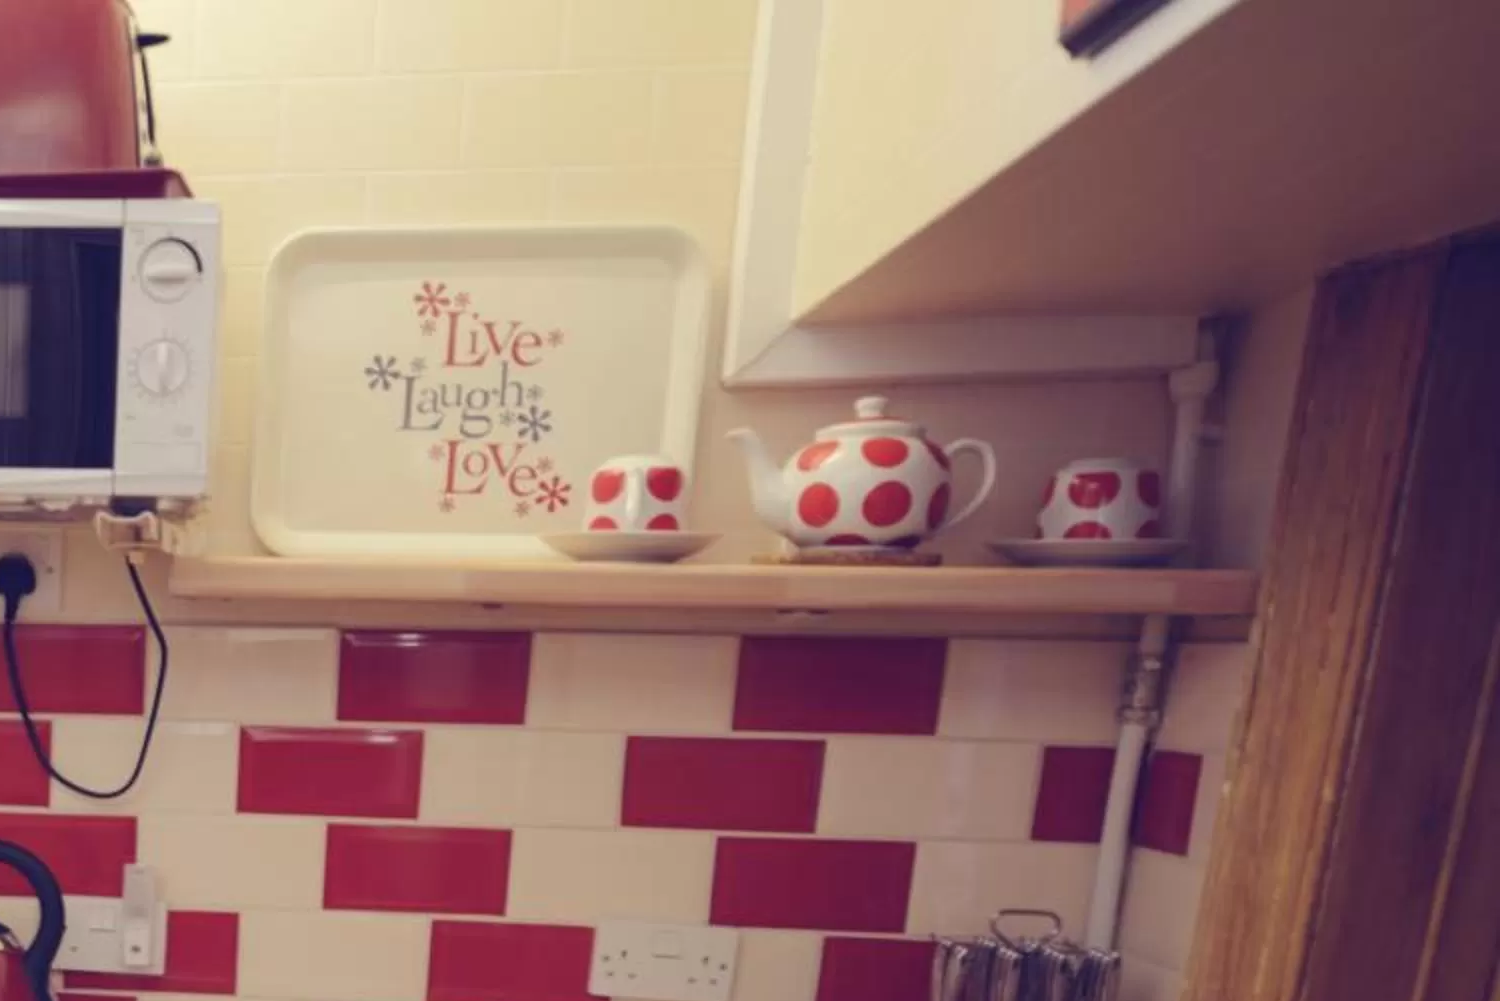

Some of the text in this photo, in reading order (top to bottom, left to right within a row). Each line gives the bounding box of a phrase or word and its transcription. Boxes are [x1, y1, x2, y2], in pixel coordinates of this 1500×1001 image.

[442, 310, 544, 368] Live
[396, 360, 524, 439] Laugh
[442, 438, 539, 498] Love
